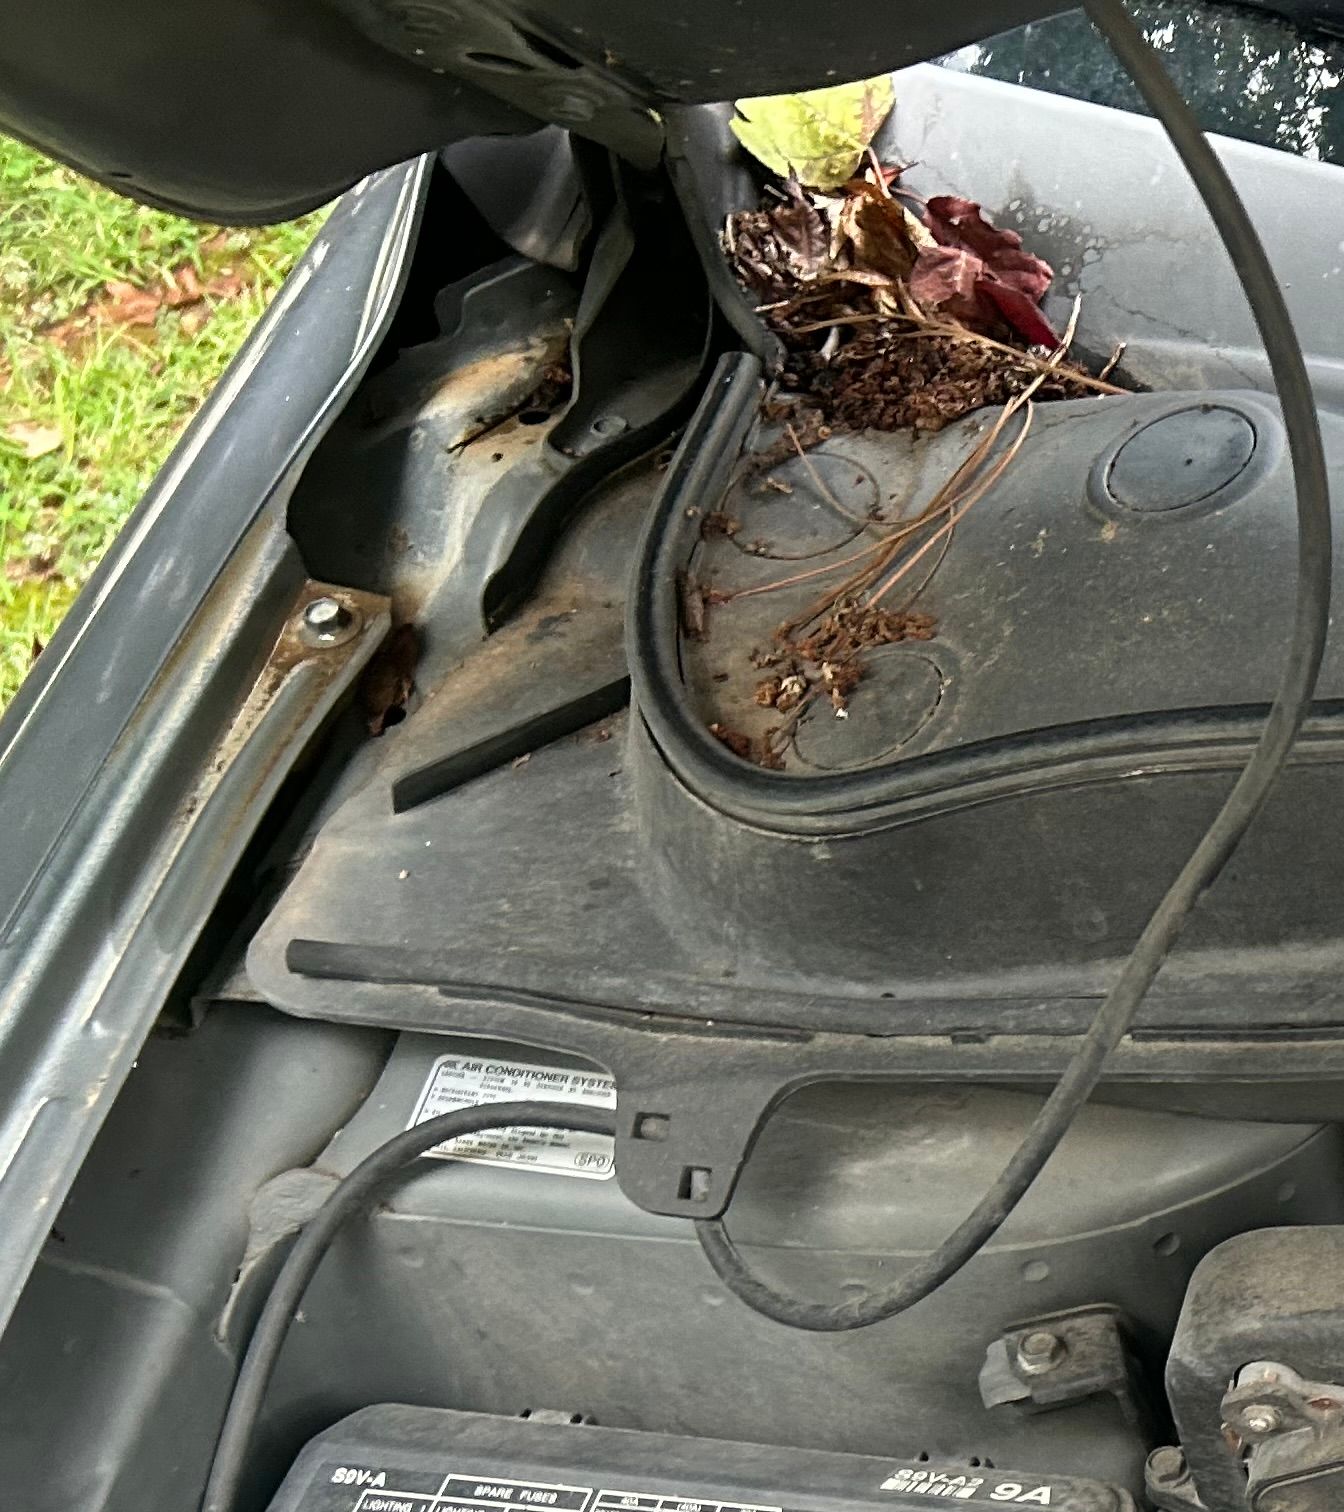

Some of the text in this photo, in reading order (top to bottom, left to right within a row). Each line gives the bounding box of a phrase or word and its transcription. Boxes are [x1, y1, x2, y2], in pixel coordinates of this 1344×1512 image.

[462, 1062, 482, 1073] AIR
[485, 1065, 569, 1083] CONDITIONER
[474, 1485, 558, 1505] SPARE FUSES
[990, 1483, 1052, 1505] 9A
